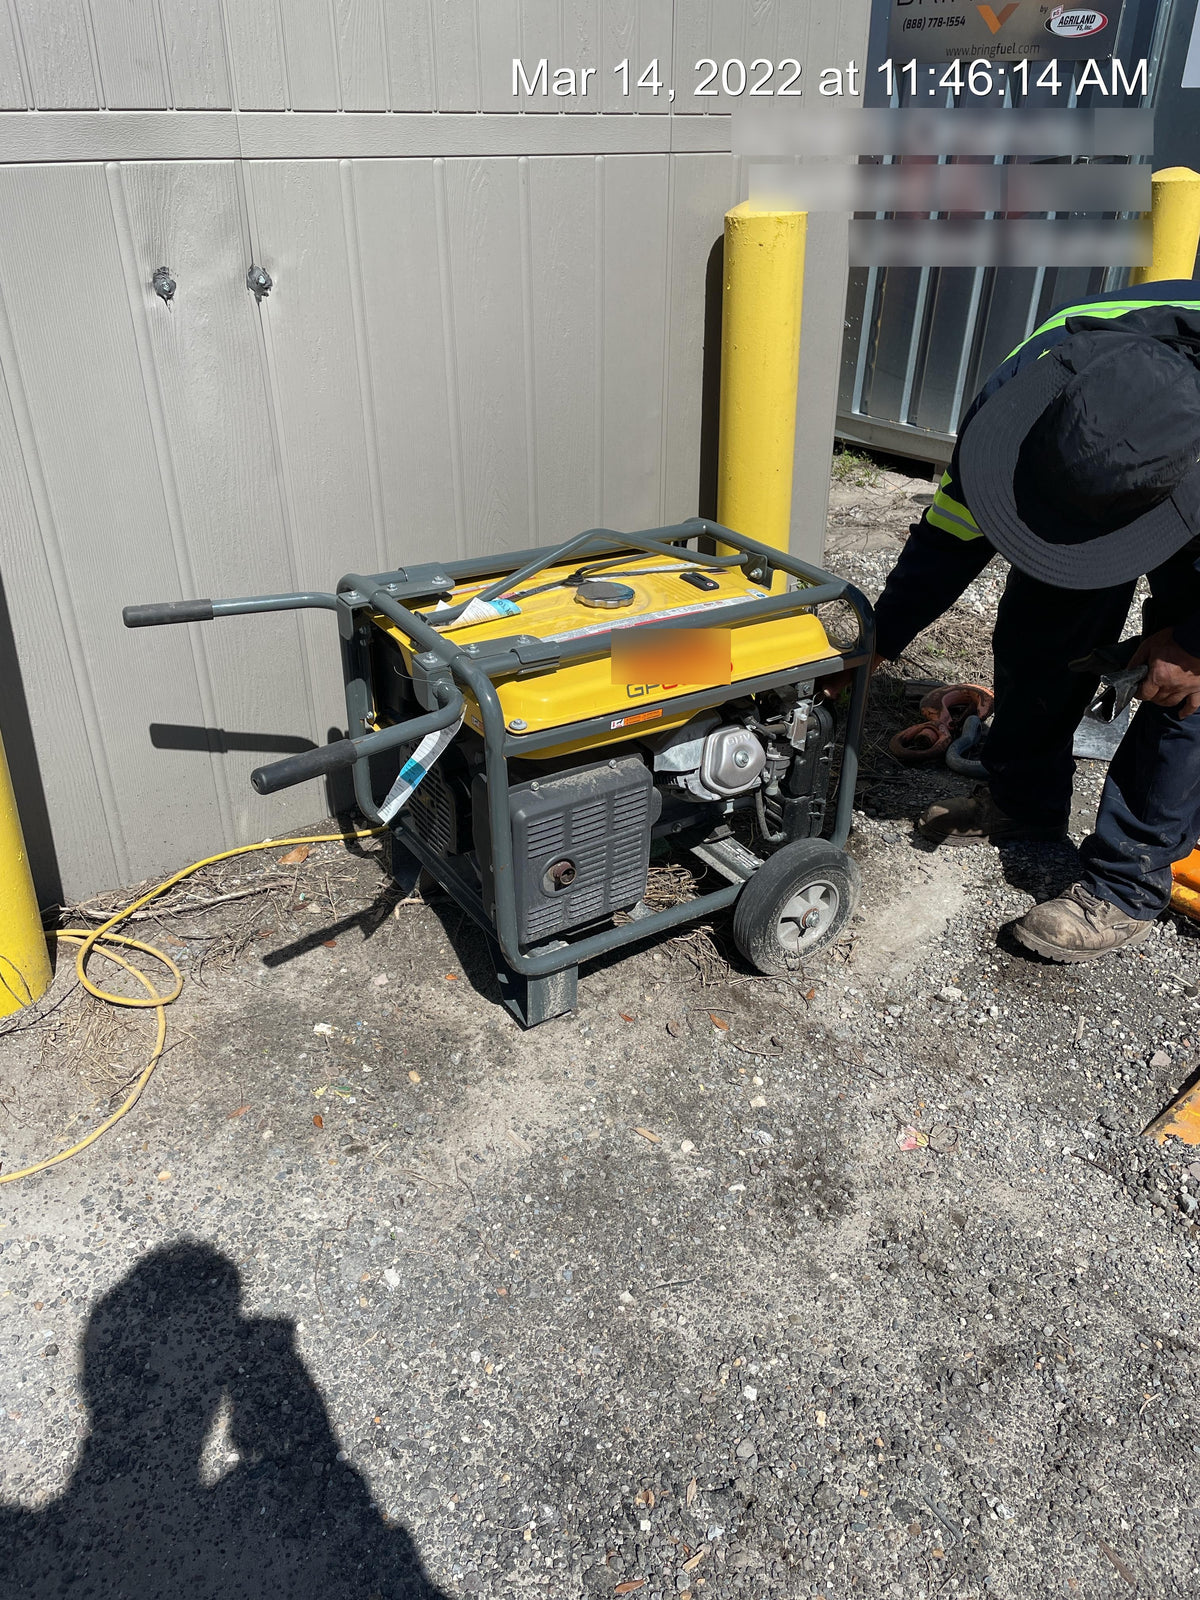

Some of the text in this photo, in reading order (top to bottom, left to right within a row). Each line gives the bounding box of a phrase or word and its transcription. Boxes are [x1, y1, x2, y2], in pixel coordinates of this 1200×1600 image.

[1040, 5, 1048, 14] by
[902, 15, 966, 32] (888) 778-1554
[1058, 14, 1097, 26] AGRILAND
[945, 42, 1041, 58] www.bringfuel.com
